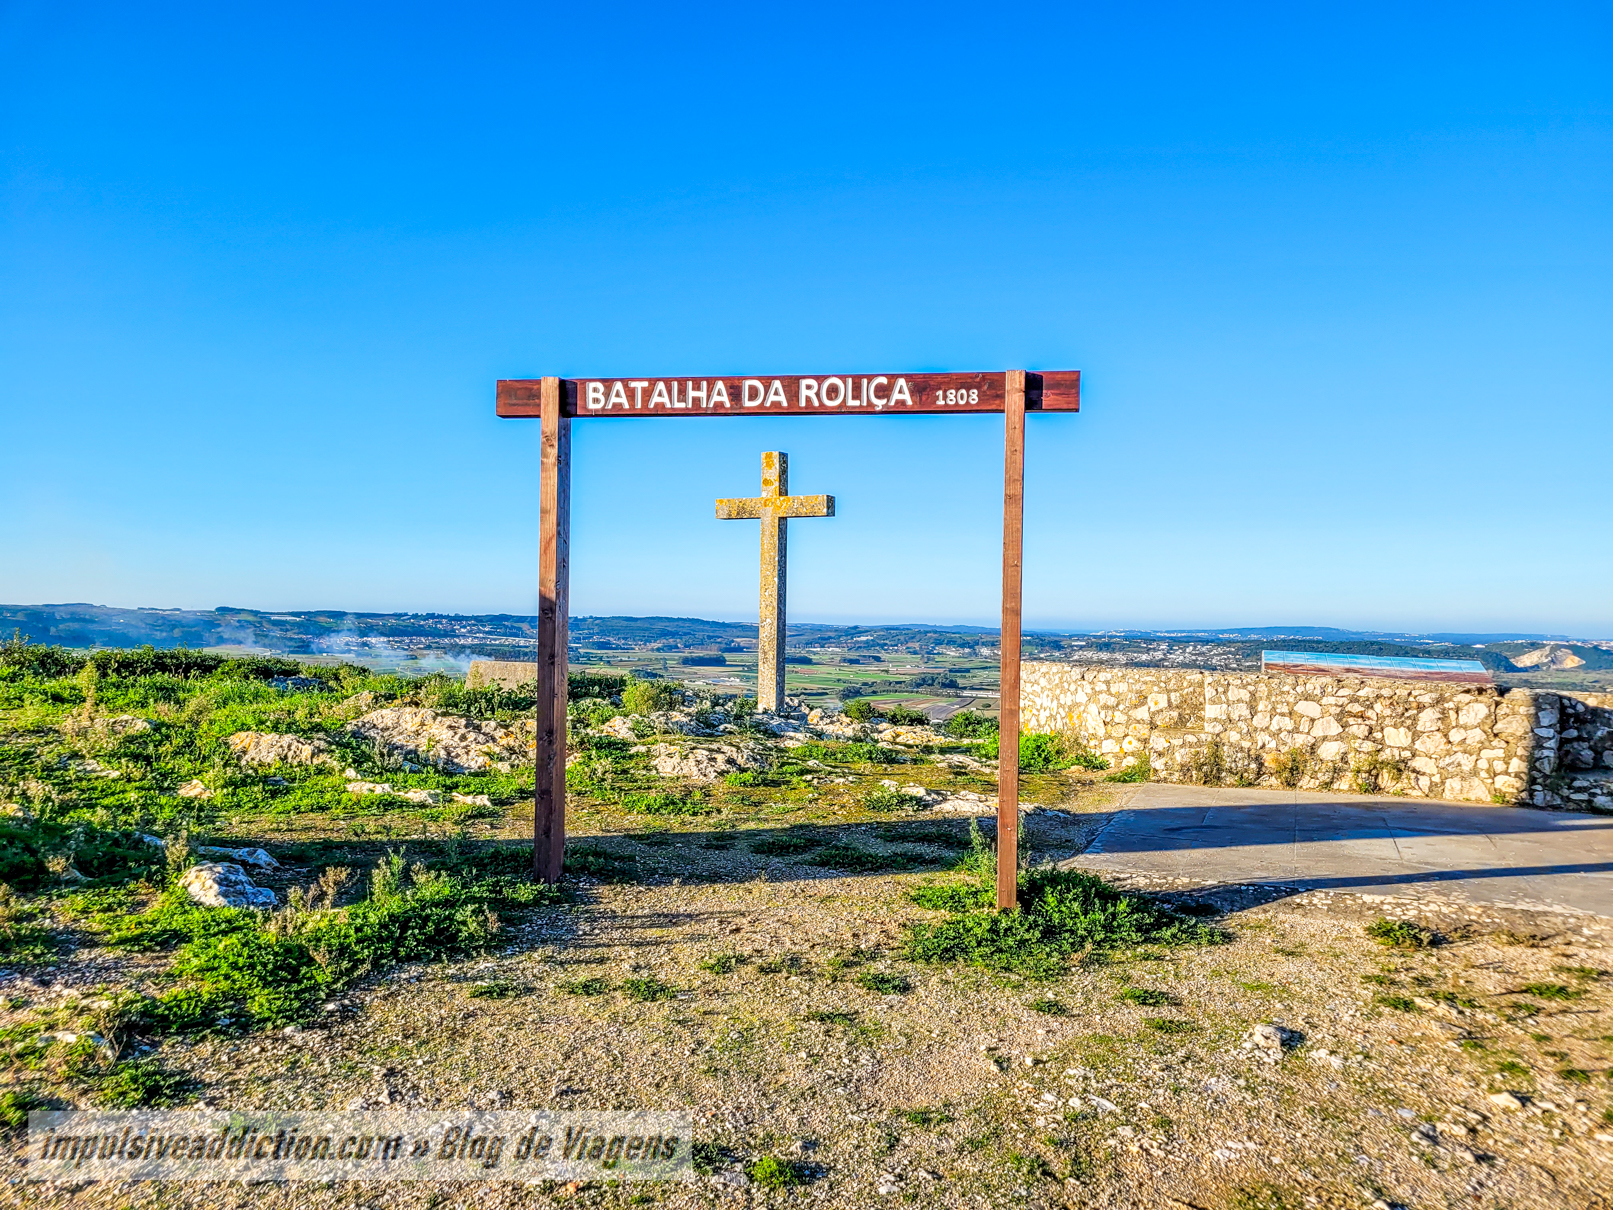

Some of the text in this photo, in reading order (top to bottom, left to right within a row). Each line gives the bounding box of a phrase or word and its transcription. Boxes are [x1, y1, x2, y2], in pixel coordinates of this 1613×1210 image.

[586, 376, 979, 410] BATALHA DA ROLIÇA 1808
